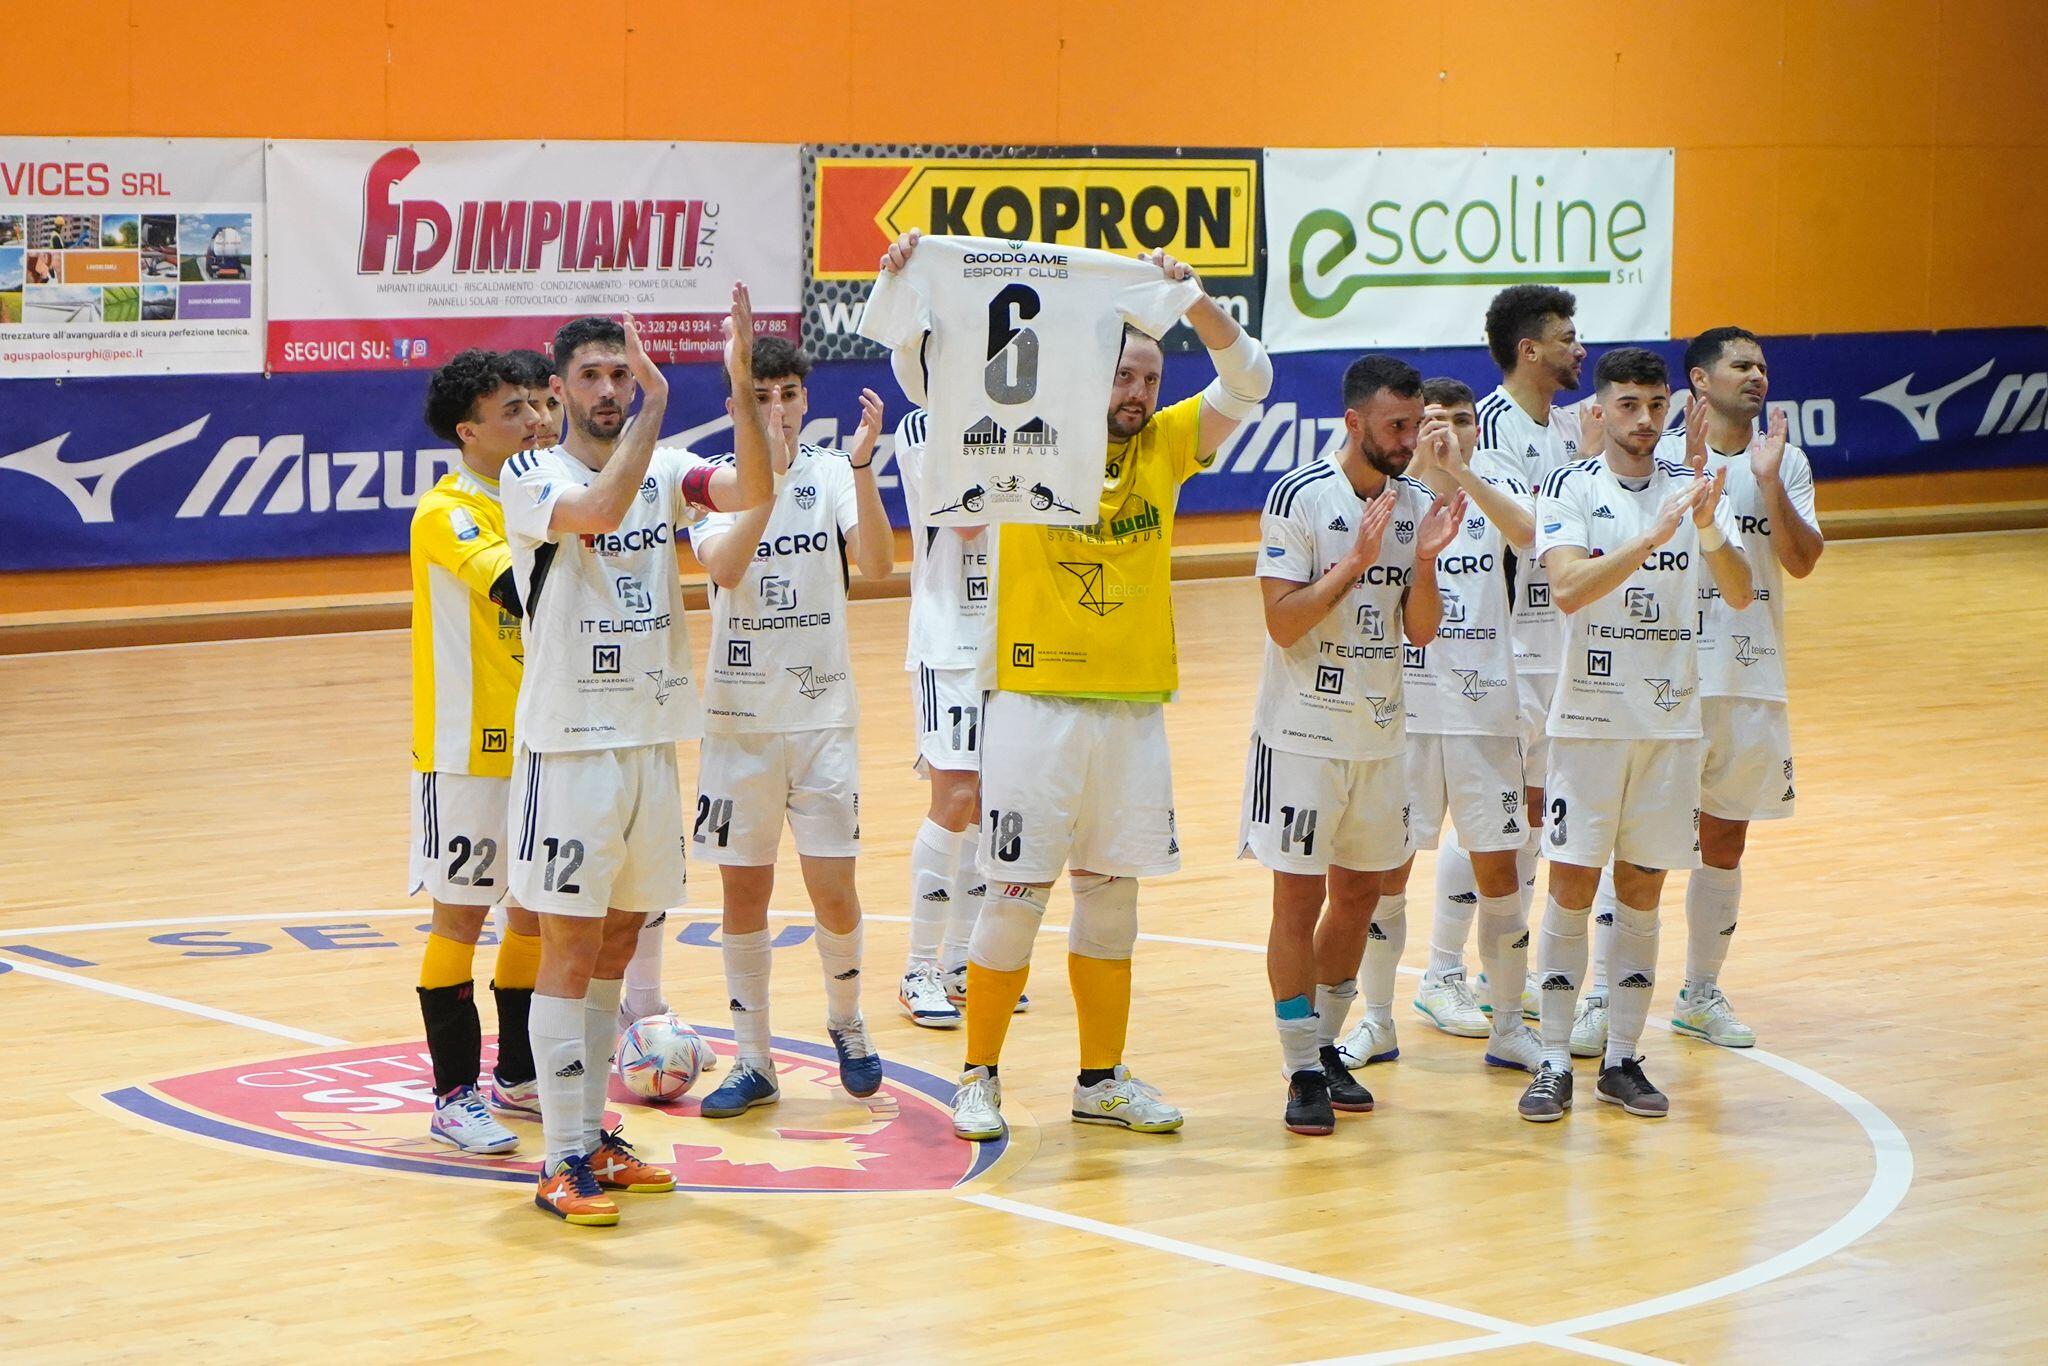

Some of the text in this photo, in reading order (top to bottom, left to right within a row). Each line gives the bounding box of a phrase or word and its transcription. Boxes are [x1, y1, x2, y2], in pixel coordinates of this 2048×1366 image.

[121, 173, 171, 196] SRL
[930, 185, 1231, 249] KOPRON
[1289, 174, 1646, 319] escoline
[963, 253, 1068, 265] GOODGAME
[963, 267, 1069, 279] ESPORT CLUB
[1616, 268, 1643, 284] Srl
[376, 283, 415, 293] IMPIANTI
[417, 283, 458, 292] IDRAULICI
[464, 281, 534, 292] RISCALDAMENTO
[541, 280, 622, 290] CONDIZIONAMENTO
[629, 279, 660, 289] POMPE
[669, 279, 697, 288] CALORE
[428, 293, 655, 306] PANNELLI SOLARI FOTOVOLTAICO ANTINCENDIO GAS
[648, 320, 664, 332] 328
[666, 320, 677, 331] 29
[768, 319, 787, 331] 885
[52, 330, 121, 340] all'avanguardia
[130, 329, 138, 337] di
[141, 329, 167, 337] sicura
[169, 328, 215, 339] perfezione
[984, 283, 1041, 405] 6
[284, 341, 355, 362] SEGUICI
[963, 447, 1060, 456] SYSTEM HAUS
[794, 486, 816, 498] 360
[1593, 511, 1615, 520] adidas
[1395, 521, 1414, 532] 360
[1467, 516, 1484, 529] 360
[580, 620, 596, 633] IT
[729, 617, 740, 630] IT
[1587, 624, 1598, 636] IT
[1320, 640, 1334, 653] IT
[816, 672, 846, 684] teleco
[1479, 678, 1507, 688] teleco
[948, 706, 978, 751] 11
[1502, 791, 1518, 802] 360
[694, 794, 733, 847] 24
[990, 809, 1024, 862] 18
[1281, 806, 1318, 856] 14
[448, 835, 497, 886] 22
[543, 837, 585, 894] 12
[922, 893, 950, 902] adidas
[1542, 982, 1574, 991] adidas
[1618, 981, 1652, 989] adidas
